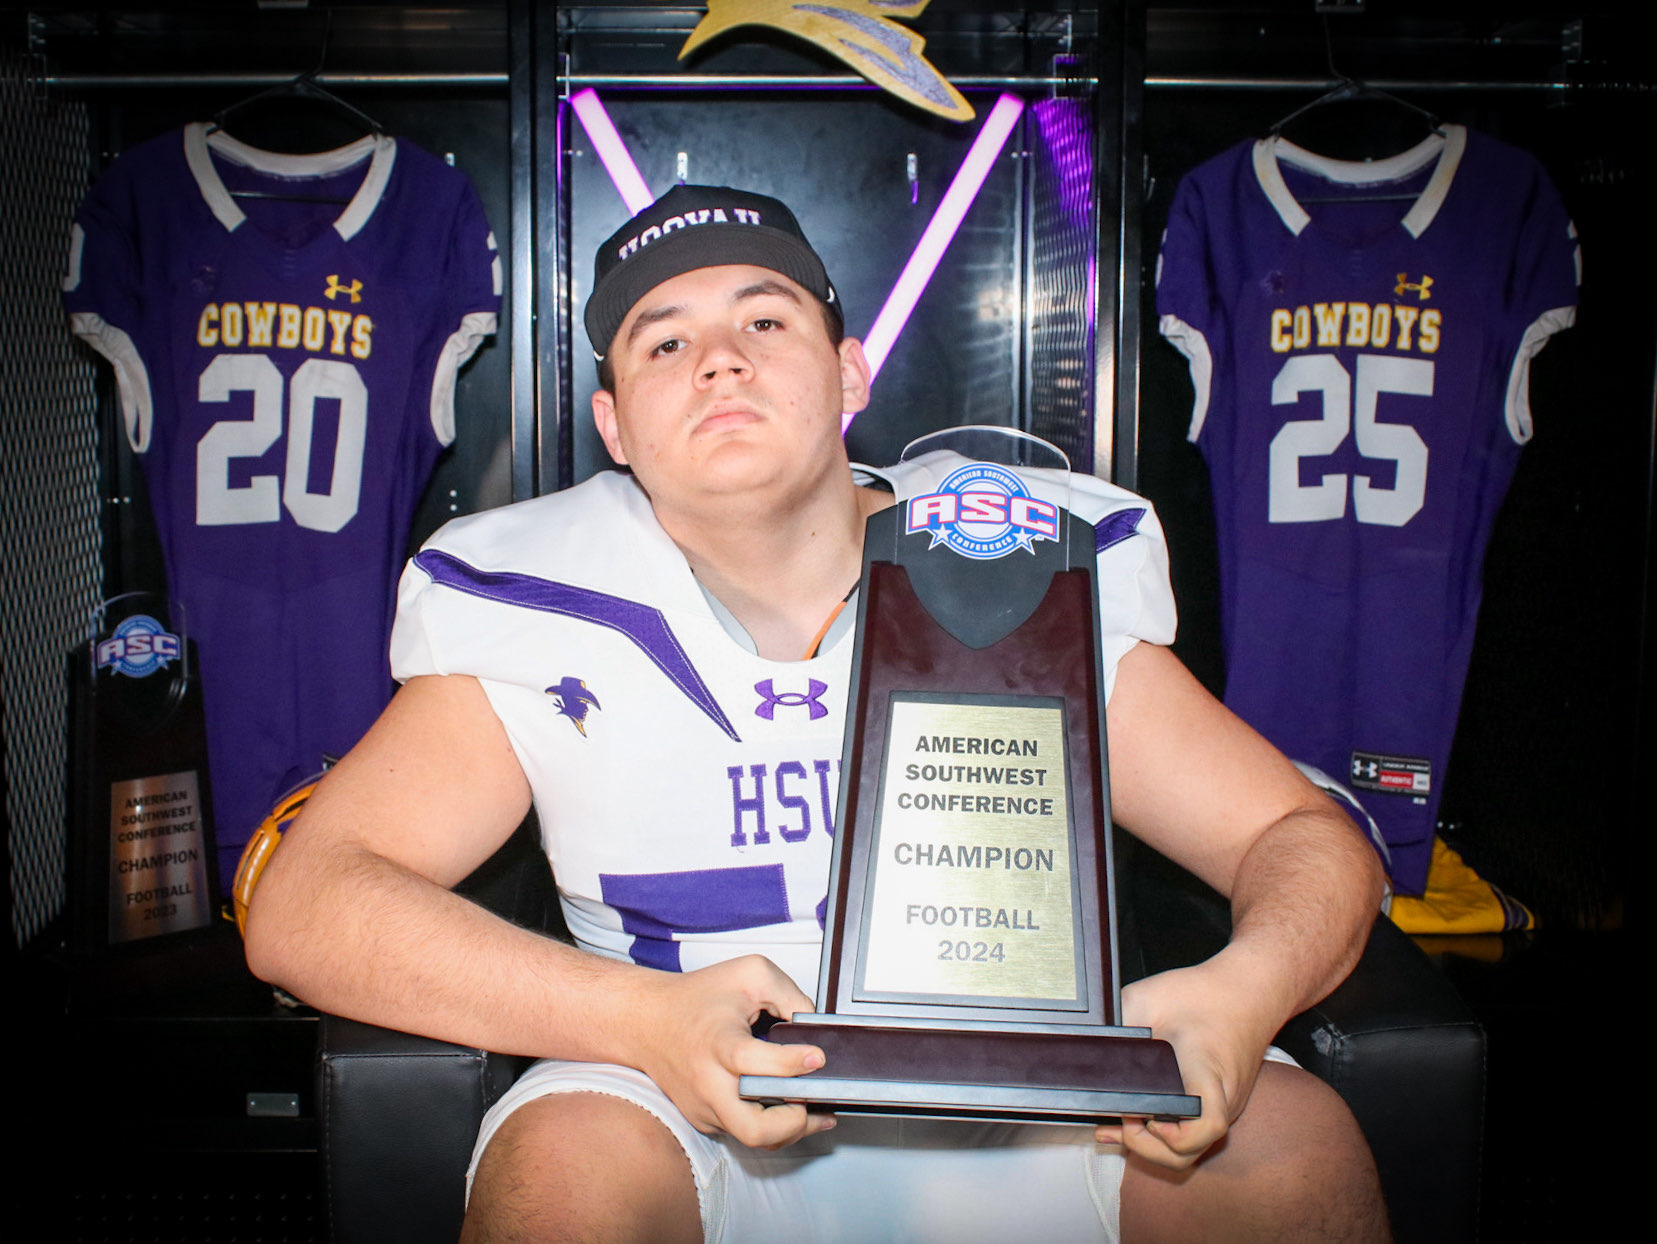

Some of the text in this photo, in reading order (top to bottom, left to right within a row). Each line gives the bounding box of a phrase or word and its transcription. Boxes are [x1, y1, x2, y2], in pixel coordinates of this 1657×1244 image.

[197, 301, 373, 360] COWBOYS
[1270, 301, 1443, 354] COWBOYS
[196, 353, 369, 534] 20
[1268, 353, 1436, 528] 25
[950, 470, 1019, 492] AMERICAN SOUTHWEST
[911, 492, 1056, 536] ASC
[951, 533, 1013, 551] CONFERENCE
[99, 634, 178, 665] ASC
[915, 735, 1038, 757] AMERICAN
[905, 763, 1047, 786] SOUTHWEST
[125, 790, 188, 808] AMERICAN
[897, 792, 1054, 816] CONFERENCE
[120, 806, 193, 826] SOUTHWEST
[117, 821, 197, 843] CONFERENCE
[118, 848, 199, 874] CHAMPION
[893, 842, 1054, 872] CHAMPION
[126, 884, 193, 905] FOOTBALL
[905, 904, 1040, 931] FOOTBALL
[937, 939, 1006, 963] 2024
